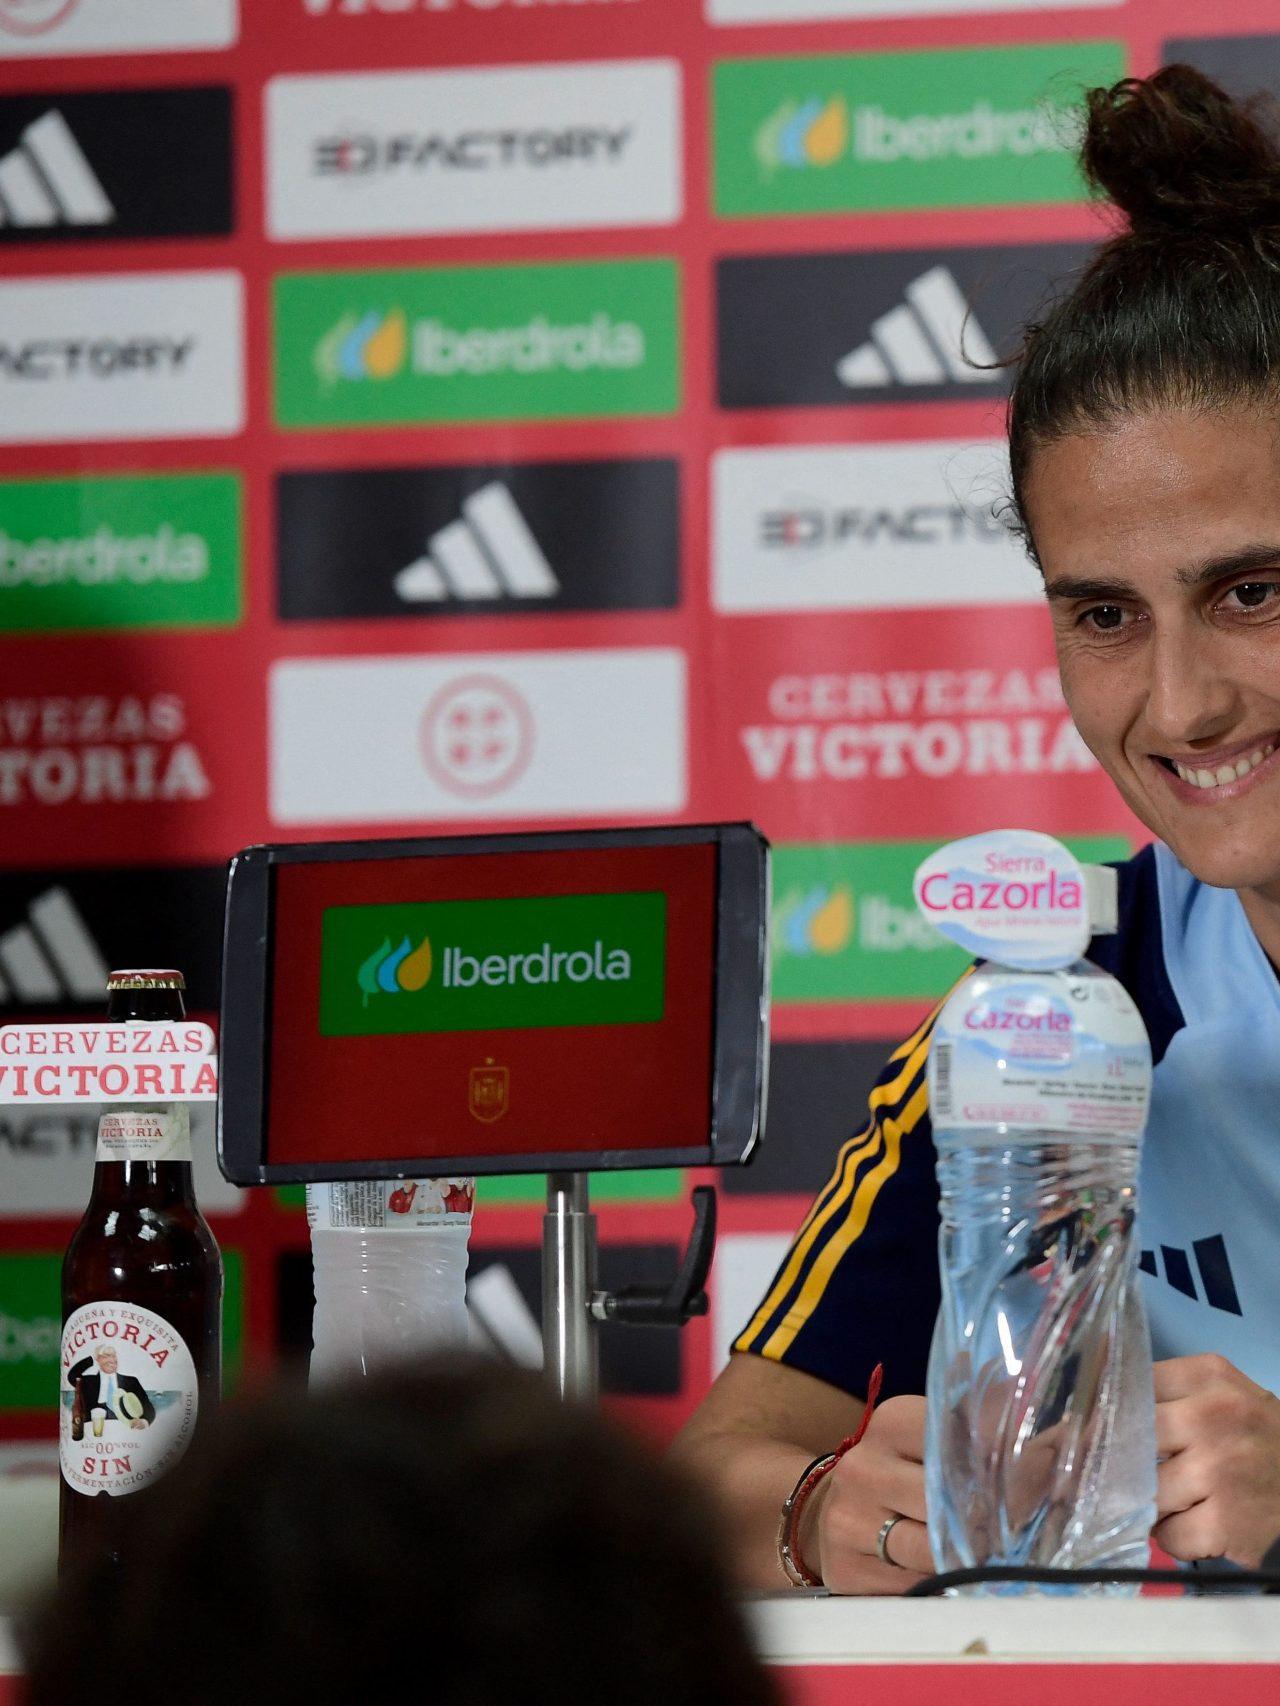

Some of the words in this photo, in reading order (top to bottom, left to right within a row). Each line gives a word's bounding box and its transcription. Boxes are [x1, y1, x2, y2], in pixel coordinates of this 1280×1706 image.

[384, 125, 632, 171] FACTORY
[414, 313, 644, 376] Iberdrola
[0, 692, 185, 744] VEZAS
[740, 719, 1097, 781] VICTORIA
[985, 852, 1046, 874] Sierra
[919, 869, 1082, 911] Cazorla
[443, 940, 632, 988] Iberdrola
[964, 1007, 1072, 1031] Cazorla
[0, 1030, 204, 1055] CERVEZAS
[63, 1321, 170, 1368] VICTORIA
[82, 1455, 132, 1476] SIN
